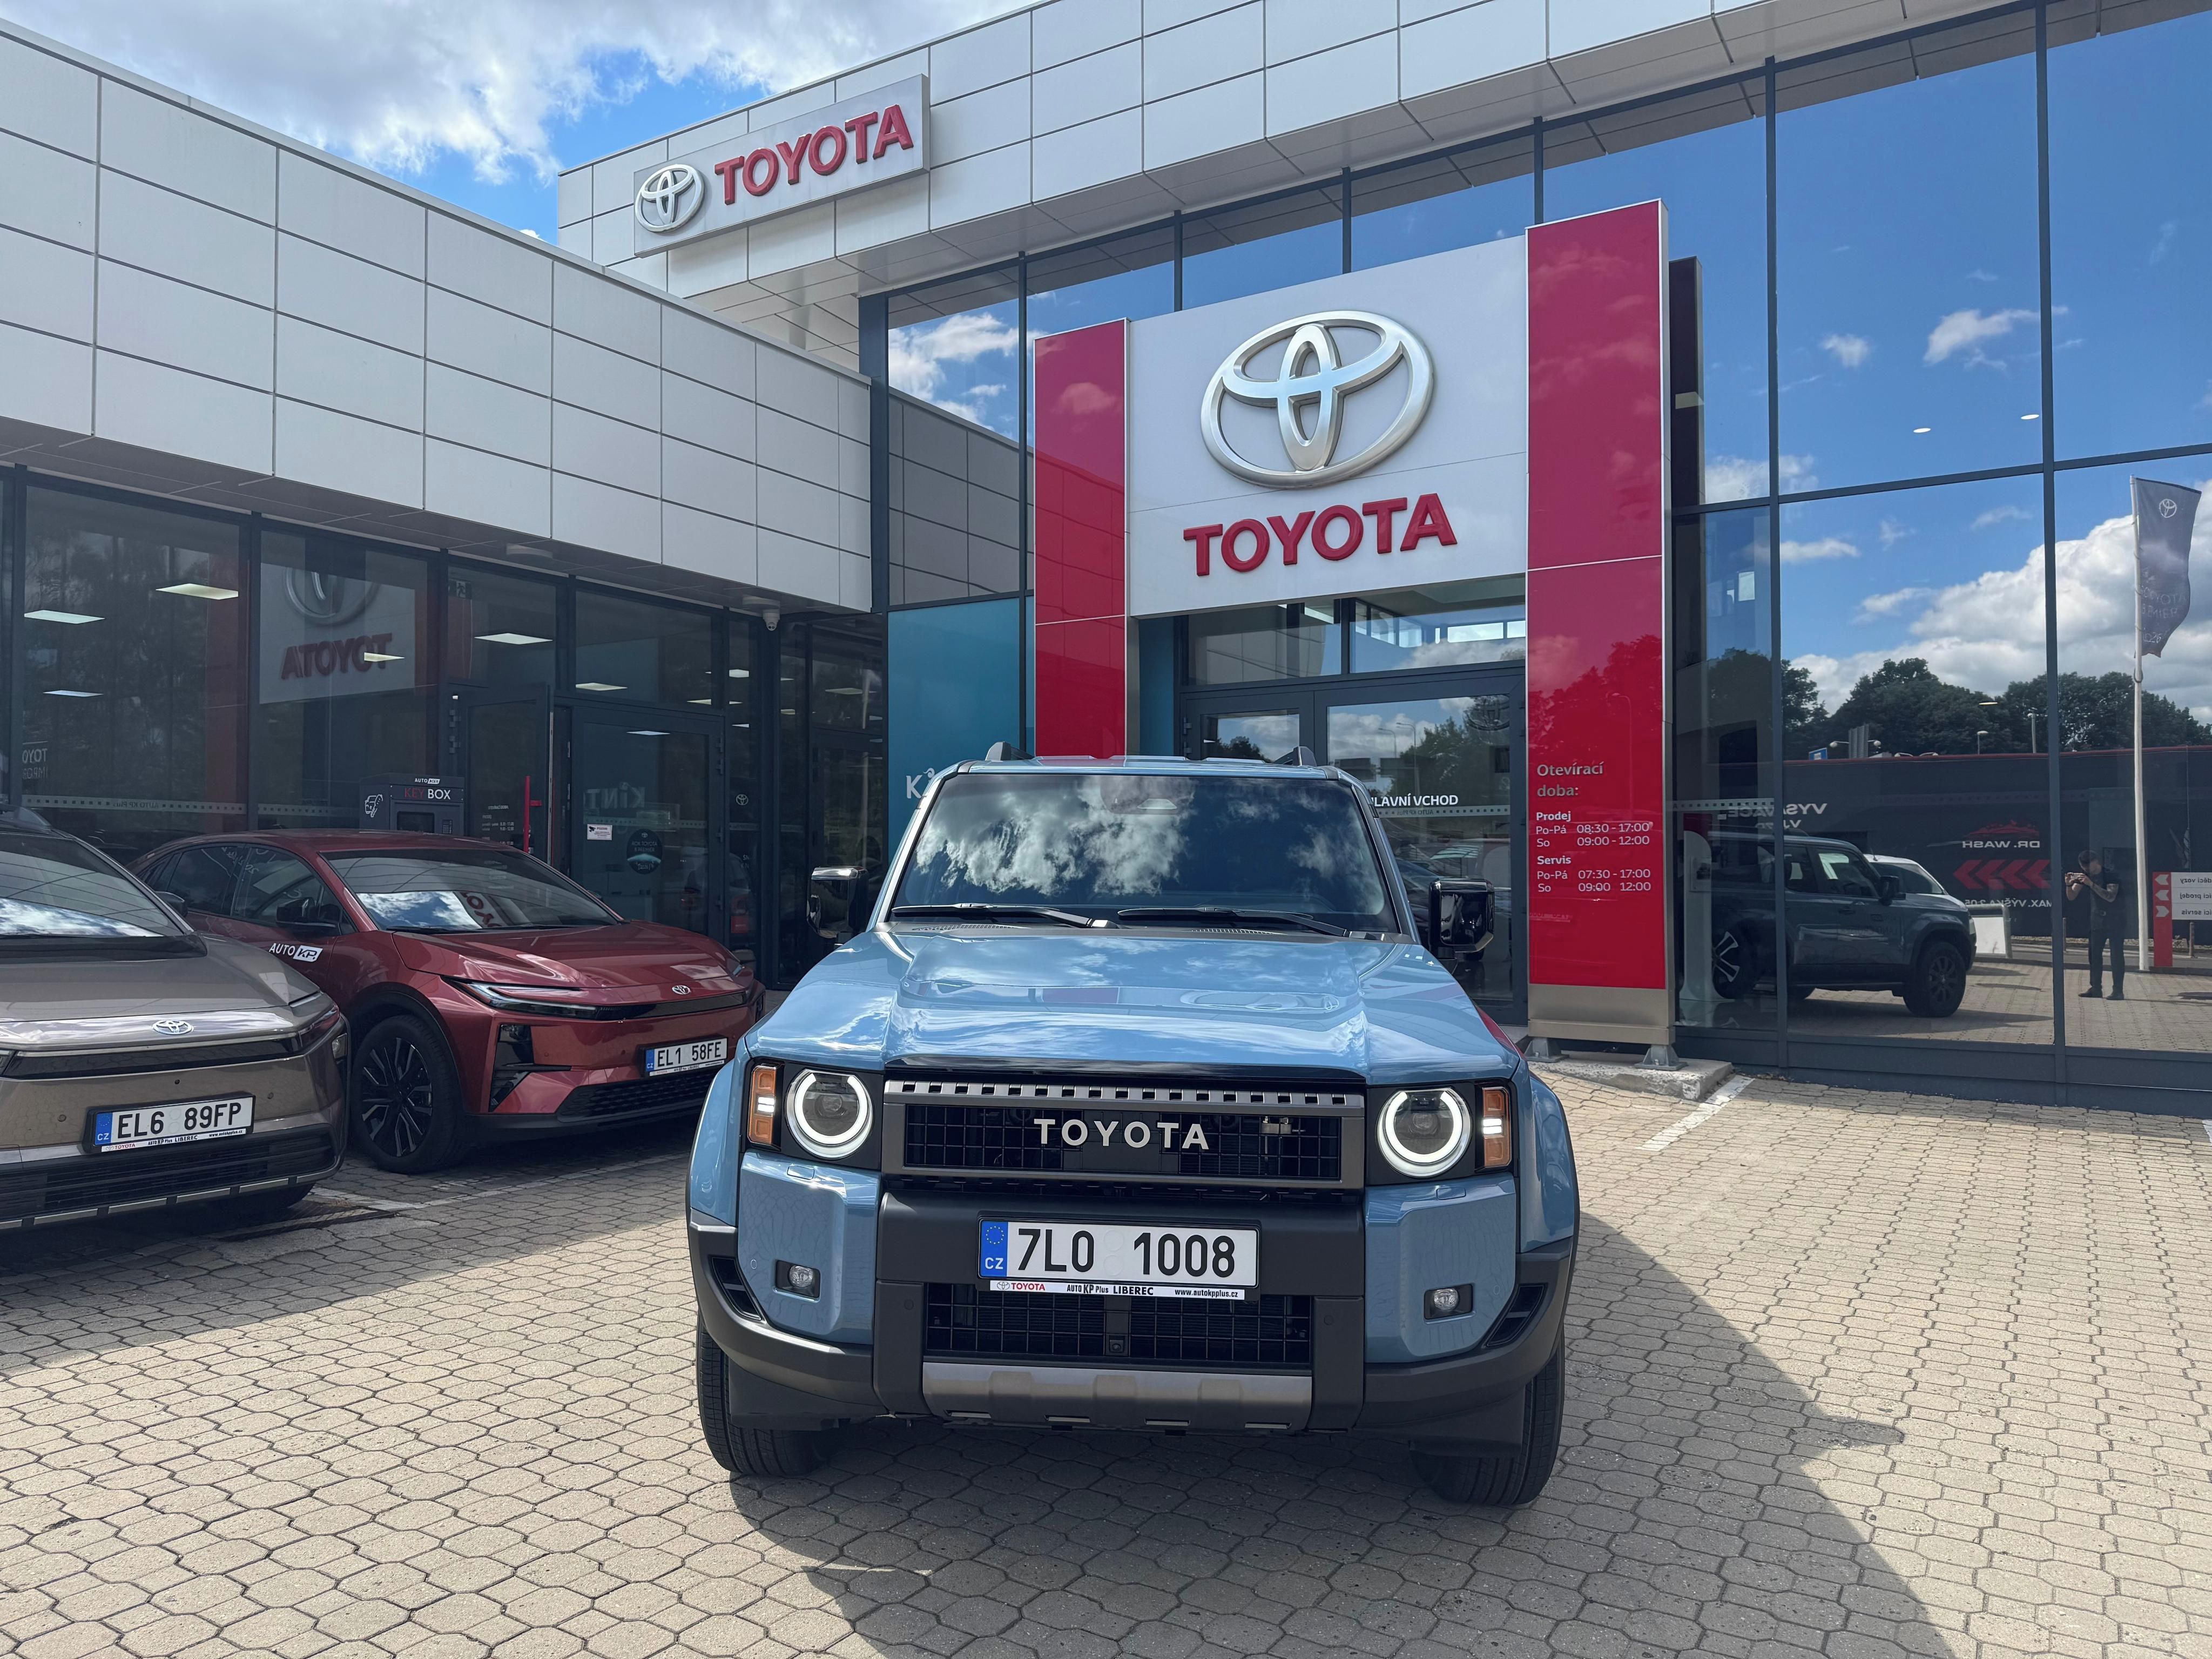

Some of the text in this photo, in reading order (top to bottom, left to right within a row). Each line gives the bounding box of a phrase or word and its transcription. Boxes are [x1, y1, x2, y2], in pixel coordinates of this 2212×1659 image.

[714, 104, 914, 205] TOYOTA
[1183, 493, 1458, 576] TOYOTA
[1537, 761, 1604, 776] Otevírací
[404, 787, 451, 800] KEY BOX
[1537, 784, 1579, 797] doba:
[1371, 793, 1458, 807] LAVNÍ VCHOD
[1536, 811, 1571, 822] Prodej
[1536, 826, 1567, 834] Po-Pá
[1577, 824, 1609, 833] 08:30
[1618, 822, 1649, 832] 17:00
[1537, 838, 1550, 847] So
[1577, 837, 1609, 846] 09:00
[1619, 835, 1649, 845] 12:00
[1537, 855, 1572, 865] Servis
[1537, 871, 1568, 879] Po-Pá
[1578, 869, 1610, 879] 07:30
[1620, 868, 1650, 878] 17:00
[1538, 882, 1651, 892] So 09:00 12:00
[269, 943, 295, 956] AUTO
[657, 1041, 721, 1067] EL1 58FE
[117, 1102, 242, 1139] EL6 89FP
[97, 1133, 110, 1141] CZ
[174, 1135, 198, 1143] LIBEREC
[1034, 1118, 1210, 1151] TOYOTA
[1017, 1228, 1236, 1278] 7L0 1008
[984, 1257, 1003, 1270] CZ
[1011, 1282, 1238, 1298] TOYOTA AUTO KP Plus LIBEREC www.autokpplus.cz
